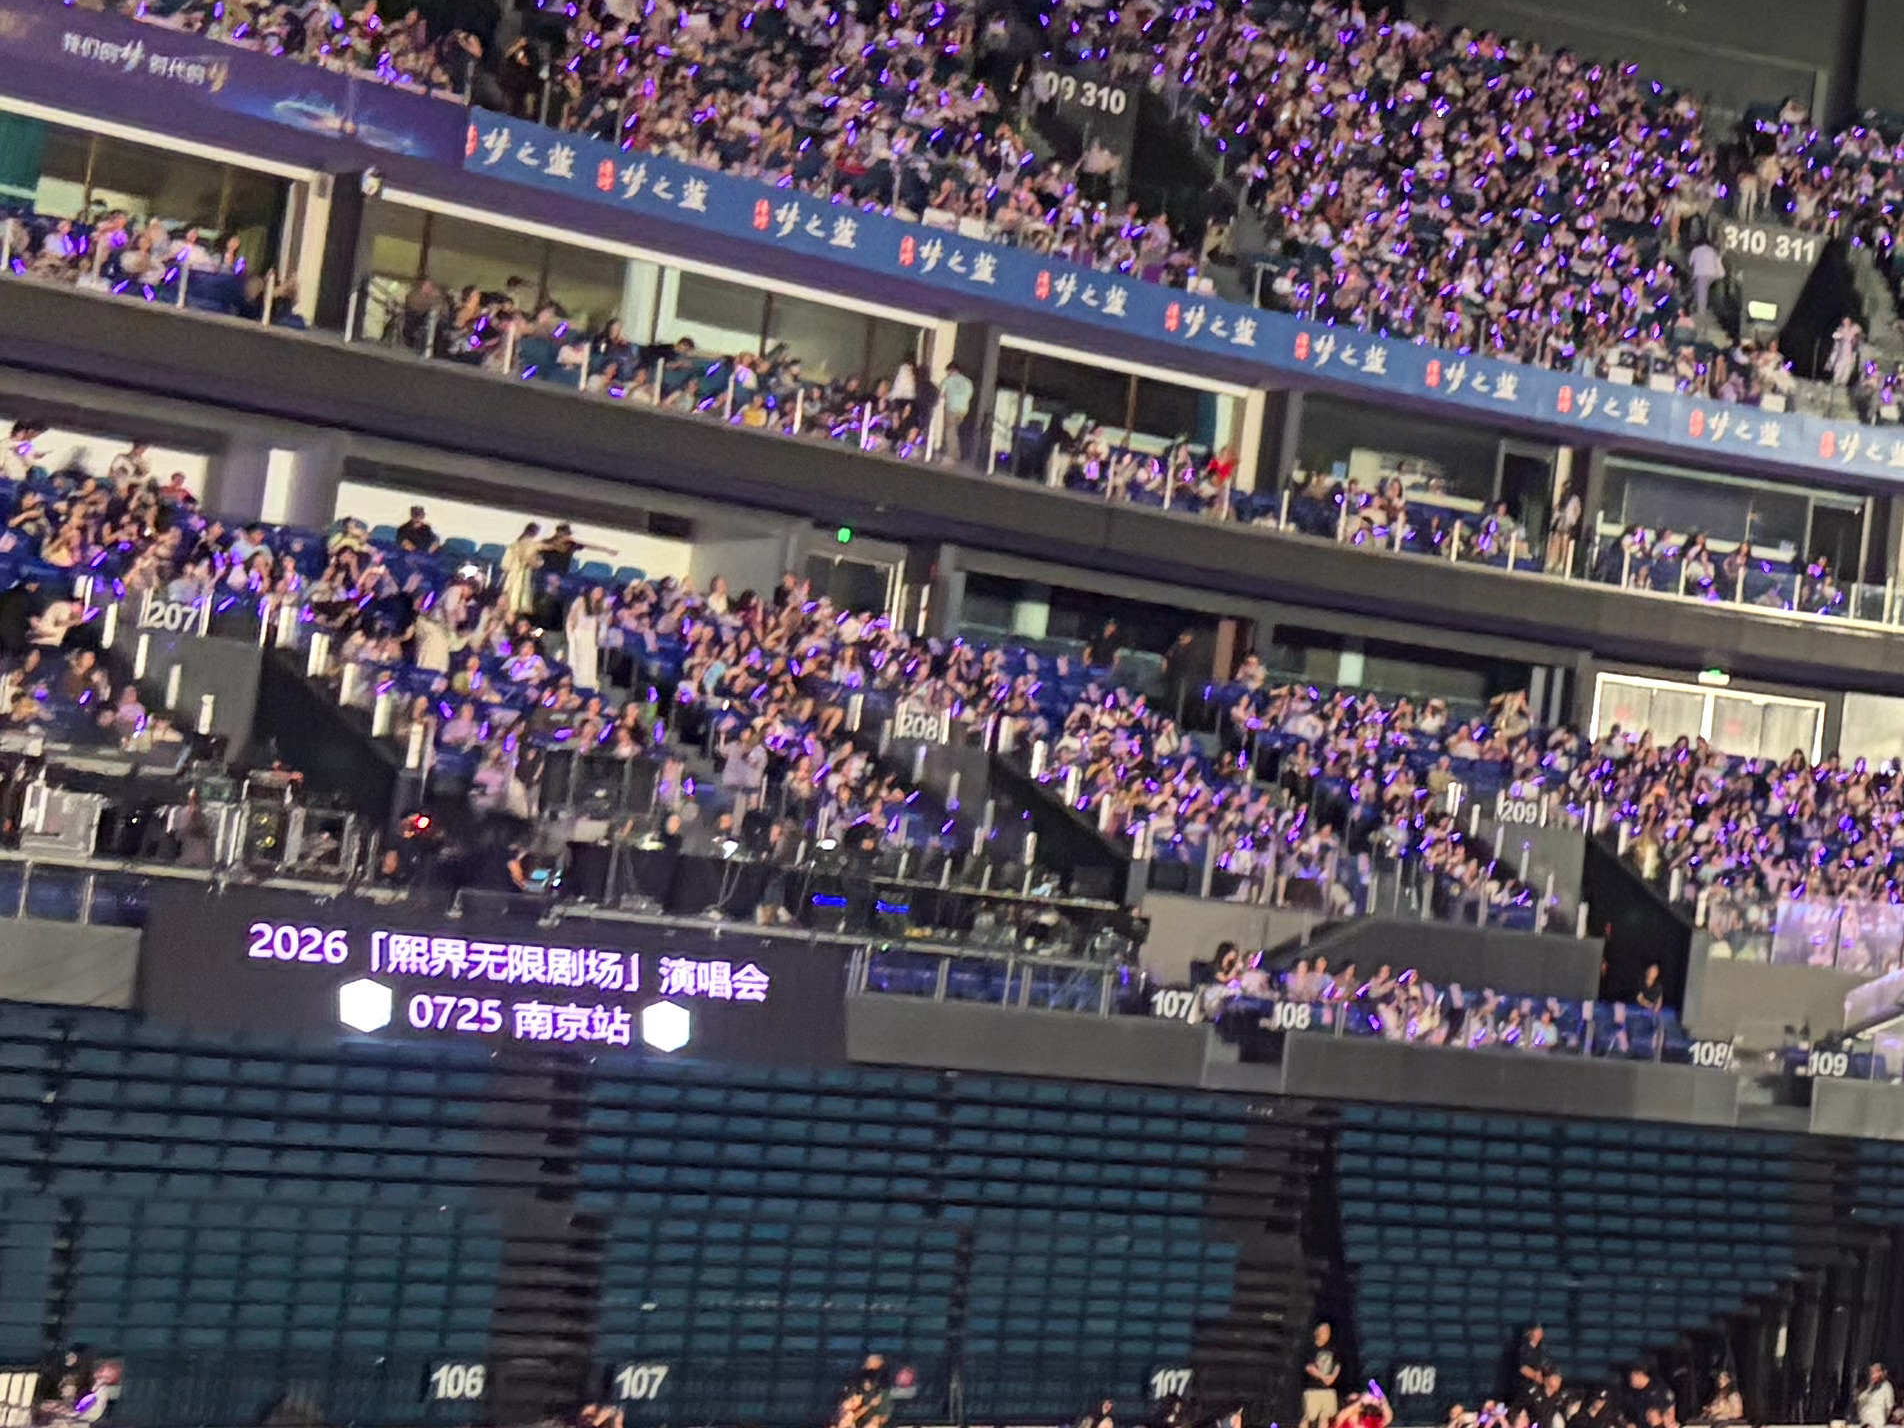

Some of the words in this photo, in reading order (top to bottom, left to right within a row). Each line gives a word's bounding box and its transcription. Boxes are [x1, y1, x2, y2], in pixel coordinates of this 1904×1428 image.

[1079, 81, 1126, 114] 310
[482, 127, 574, 179] 梦之蓝
[620, 164, 707, 213] 梦之蓝
[774, 201, 859, 250] 梦之蓝
[1723, 225, 1766, 256] 310
[1775, 234, 1815, 262] 311
[918, 239, 995, 284] 梦之蓝
[1054, 272, 1128, 317] 梦之蓝
[1183, 306, 1257, 347] 梦之蓝
[1312, 335, 1385, 376] 梦之蓝
[1444, 362, 1517, 402] 梦之蓝
[1576, 387, 1650, 426] 梦之蓝
[1709, 412, 1780, 448] 梦之蓝
[151, 599, 197, 630] 207
[901, 713, 938, 740] 208
[1502, 801, 1538, 824] 209
[247, 922, 349, 964] 2026
[659, 956, 770, 1003] 演唱会
[408, 994, 503, 1033] 0725
[513, 1000, 632, 1046] 南京站
[1151, 990, 1194, 1019] 107
[1273, 1002, 1311, 1030] 108
[1688, 1041, 1729, 1069] 108
[1807, 1052, 1848, 1076] 109
[431, 1364, 486, 1400] 106
[615, 1364, 669, 1400] 107
[1150, 1369, 1193, 1400] 107
[1397, 1365, 1436, 1394] 108
